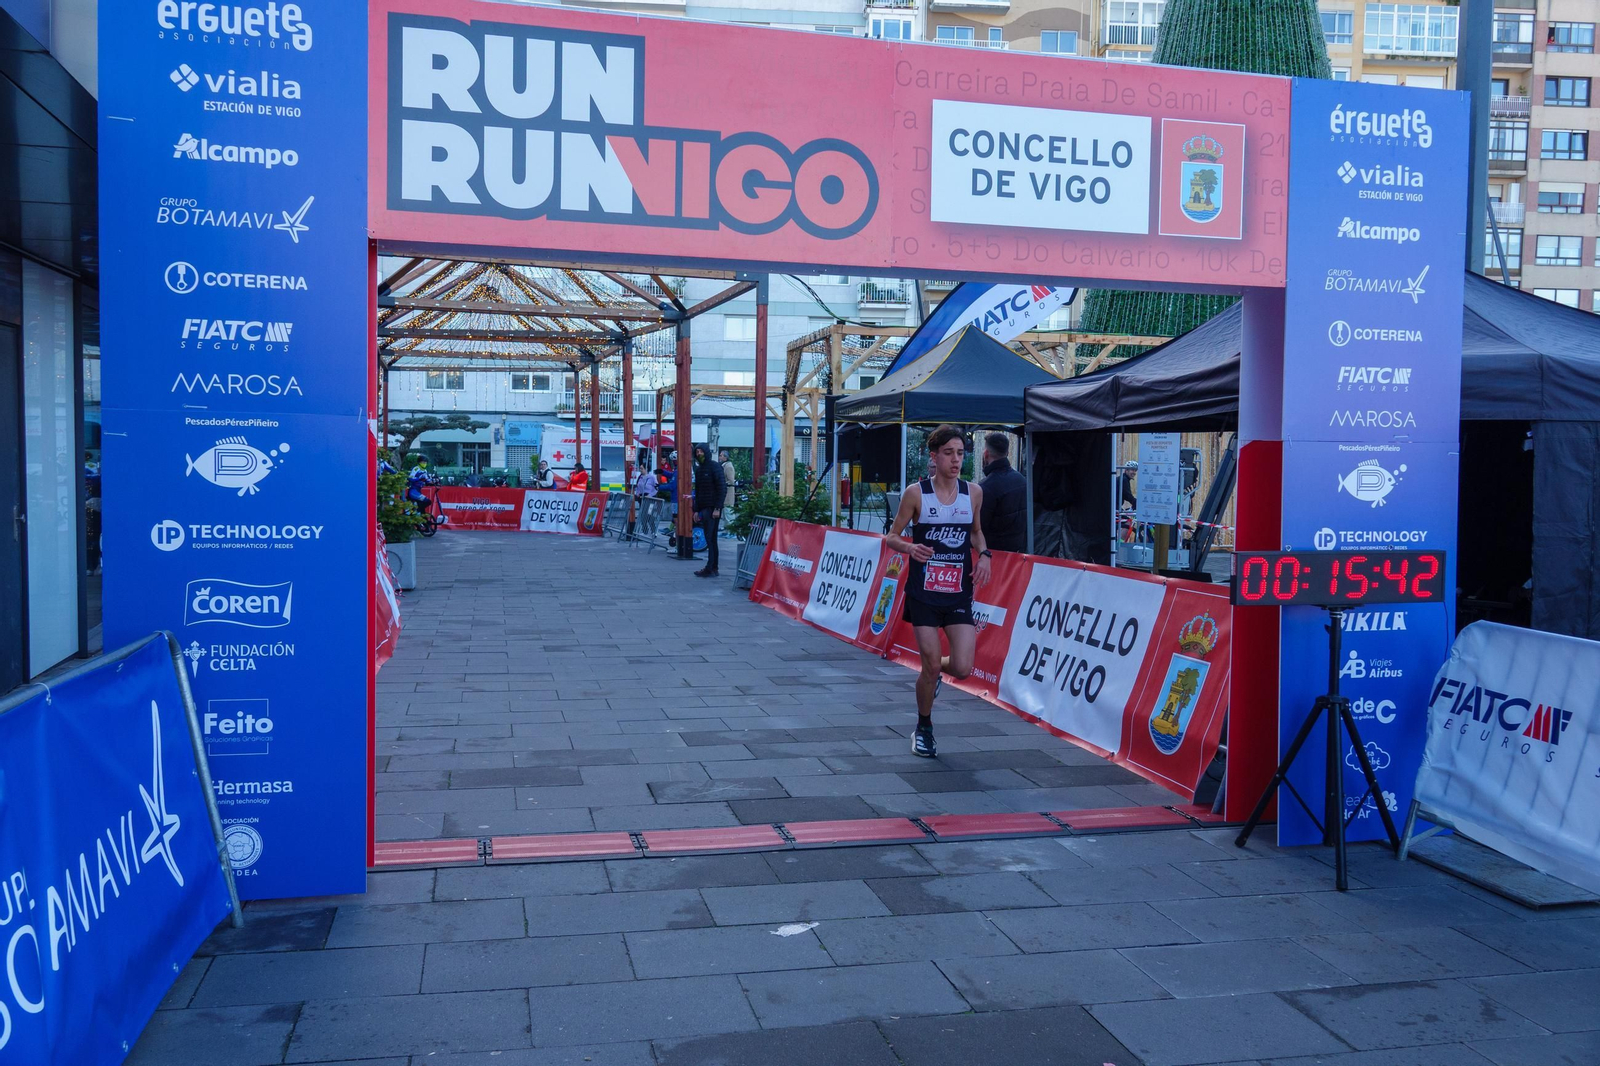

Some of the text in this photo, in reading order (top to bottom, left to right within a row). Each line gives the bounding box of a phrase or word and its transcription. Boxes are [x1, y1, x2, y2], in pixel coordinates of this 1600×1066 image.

[158, 30, 290, 50] asociación
[204, 70, 301, 100] vialia
[402, 25, 634, 126] RUN
[895, 61, 1009, 96] Carreira
[1022, 71, 1090, 102] Praia
[1101, 78, 1136, 106] De
[1147, 82, 1218, 113] Samil
[204, 100, 301, 118] ESTACIÓN DE VIGO
[173, 133, 298, 168] Alcampo
[948, 128, 1133, 168] CONCELLO
[1259, 132, 1286, 157] 21
[1330, 136, 1418, 148] asociación
[1254, 172, 1284, 197] ira
[1360, 164, 1424, 187] vialia
[970, 168, 1112, 204] DE VIGO
[1358, 190, 1392, 200] ESTACIÓN
[1406, 194, 1423, 202] VIGO
[160, 197, 198, 207] GRUPO
[156, 206, 273, 229] BOTAMAVI
[1337, 217, 1420, 244] Alcampo
[948, 234, 1000, 260] 5+5
[1014, 236, 1048, 262] Do
[1062, 238, 1170, 269] Calvario
[1250, 250, 1282, 274] De
[203, 271, 308, 290] COTERENA
[1328, 268, 1352, 277] GRUPO
[1325, 276, 1402, 293] BOTAMAVI
[967, 290, 1030, 332] IATC
[994, 294, 1060, 335] GUROS
[181, 319, 264, 341] FIATC
[1354, 328, 1422, 342] COTERENA
[180, 341, 289, 352] SEGUROS
[171, 372, 303, 396] MAROSA
[1338, 366, 1392, 384] FIATC
[185, 417, 279, 428] PescadosPérezPiñeiro
[1329, 410, 1416, 428] MAROSA
[527, 498, 578, 512] CONCELLO
[531, 512, 570, 524] DE VGO
[189, 524, 324, 539] TECHNOLOGY
[925, 526, 967, 540] delikia
[1339, 530, 1427, 543] TECHNOLOGY
[820, 550, 872, 583] CONCELLO
[938, 571, 957, 582] 642
[1240, 556, 1439, 600] 00:15:42
[816, 581, 832, 605] DE
[831, 586, 857, 613] VIGO
[1025, 595, 1139, 656] CONCELLO
[211, 641, 295, 657] FUNDACIÓN
[210, 658, 256, 671] CELTA
[1369, 668, 1402, 678] Airbus
[1370, 658, 1392, 668] Viajes
[1018, 643, 1106, 704] DE VIGO
[1429, 677, 1532, 731] FIATC
[204, 711, 273, 734] Feito
[1427, 712, 1555, 762] EGUROS
[212, 780, 293, 795] Hermasa
[1358, 808, 1371, 819] Ar
